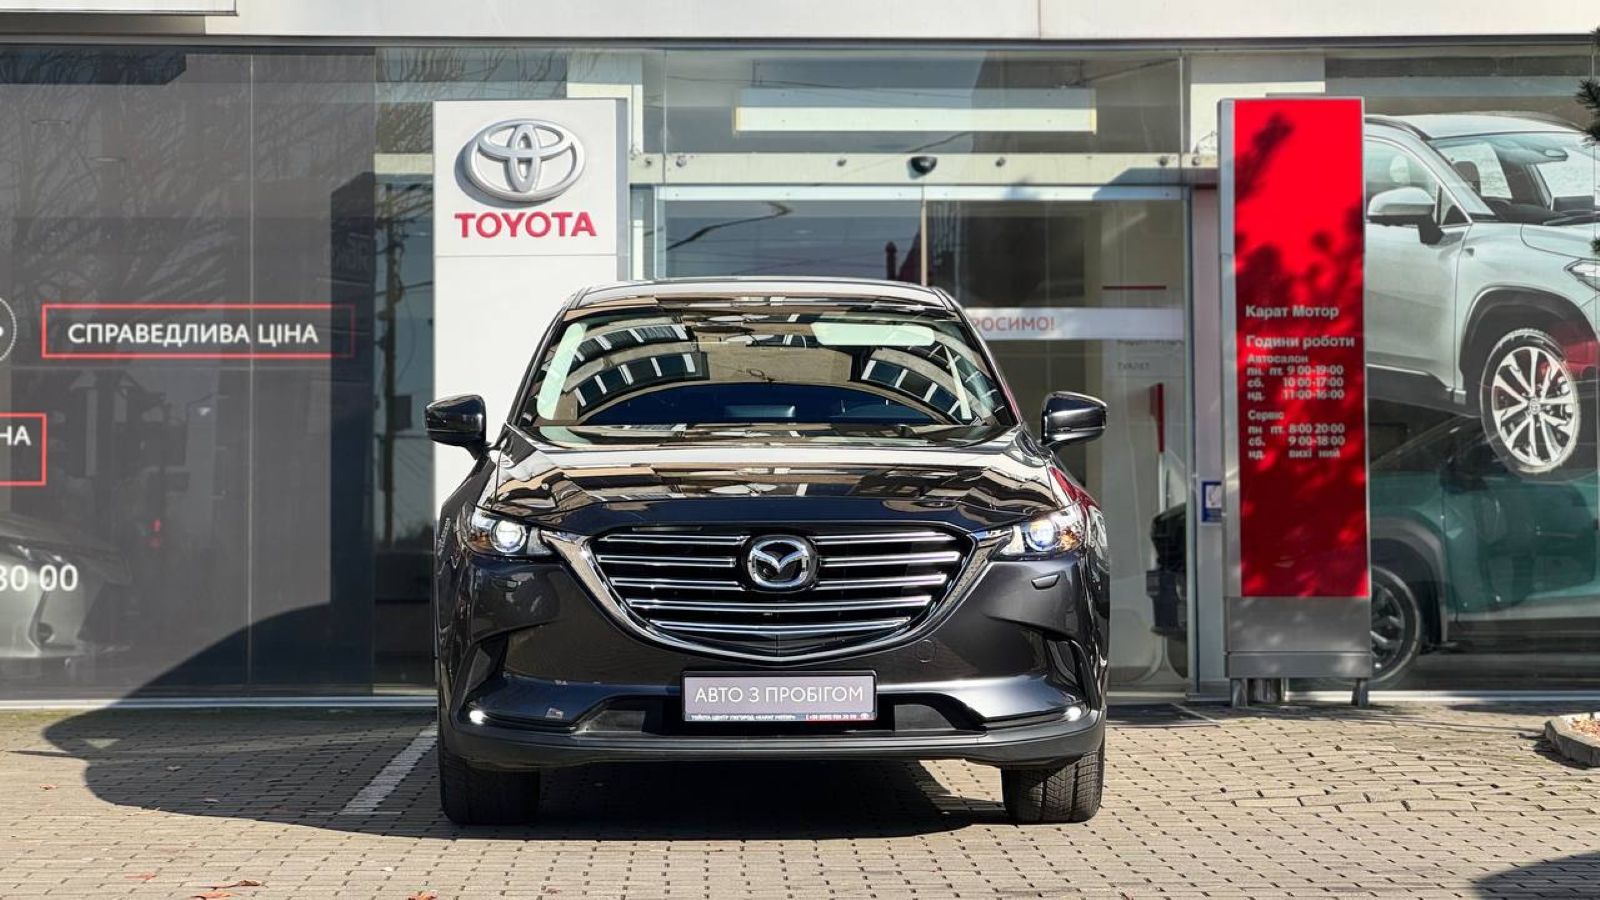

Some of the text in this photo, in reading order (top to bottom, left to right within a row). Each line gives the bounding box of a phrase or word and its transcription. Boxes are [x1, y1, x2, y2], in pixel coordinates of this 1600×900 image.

[454, 211, 596, 238] TOYOTA
[1245, 304, 1339, 320] Карат Мотор
[970, 315, 1055, 331] РОСИМО!
[67, 322, 319, 347] СПРАВЕДЛИВА ЦІНА
[1246, 335, 1355, 350] Години роботи
[39, 564, 78, 592] 00
[695, 686, 863, 703] АВТО З ПРОБІГОМ
